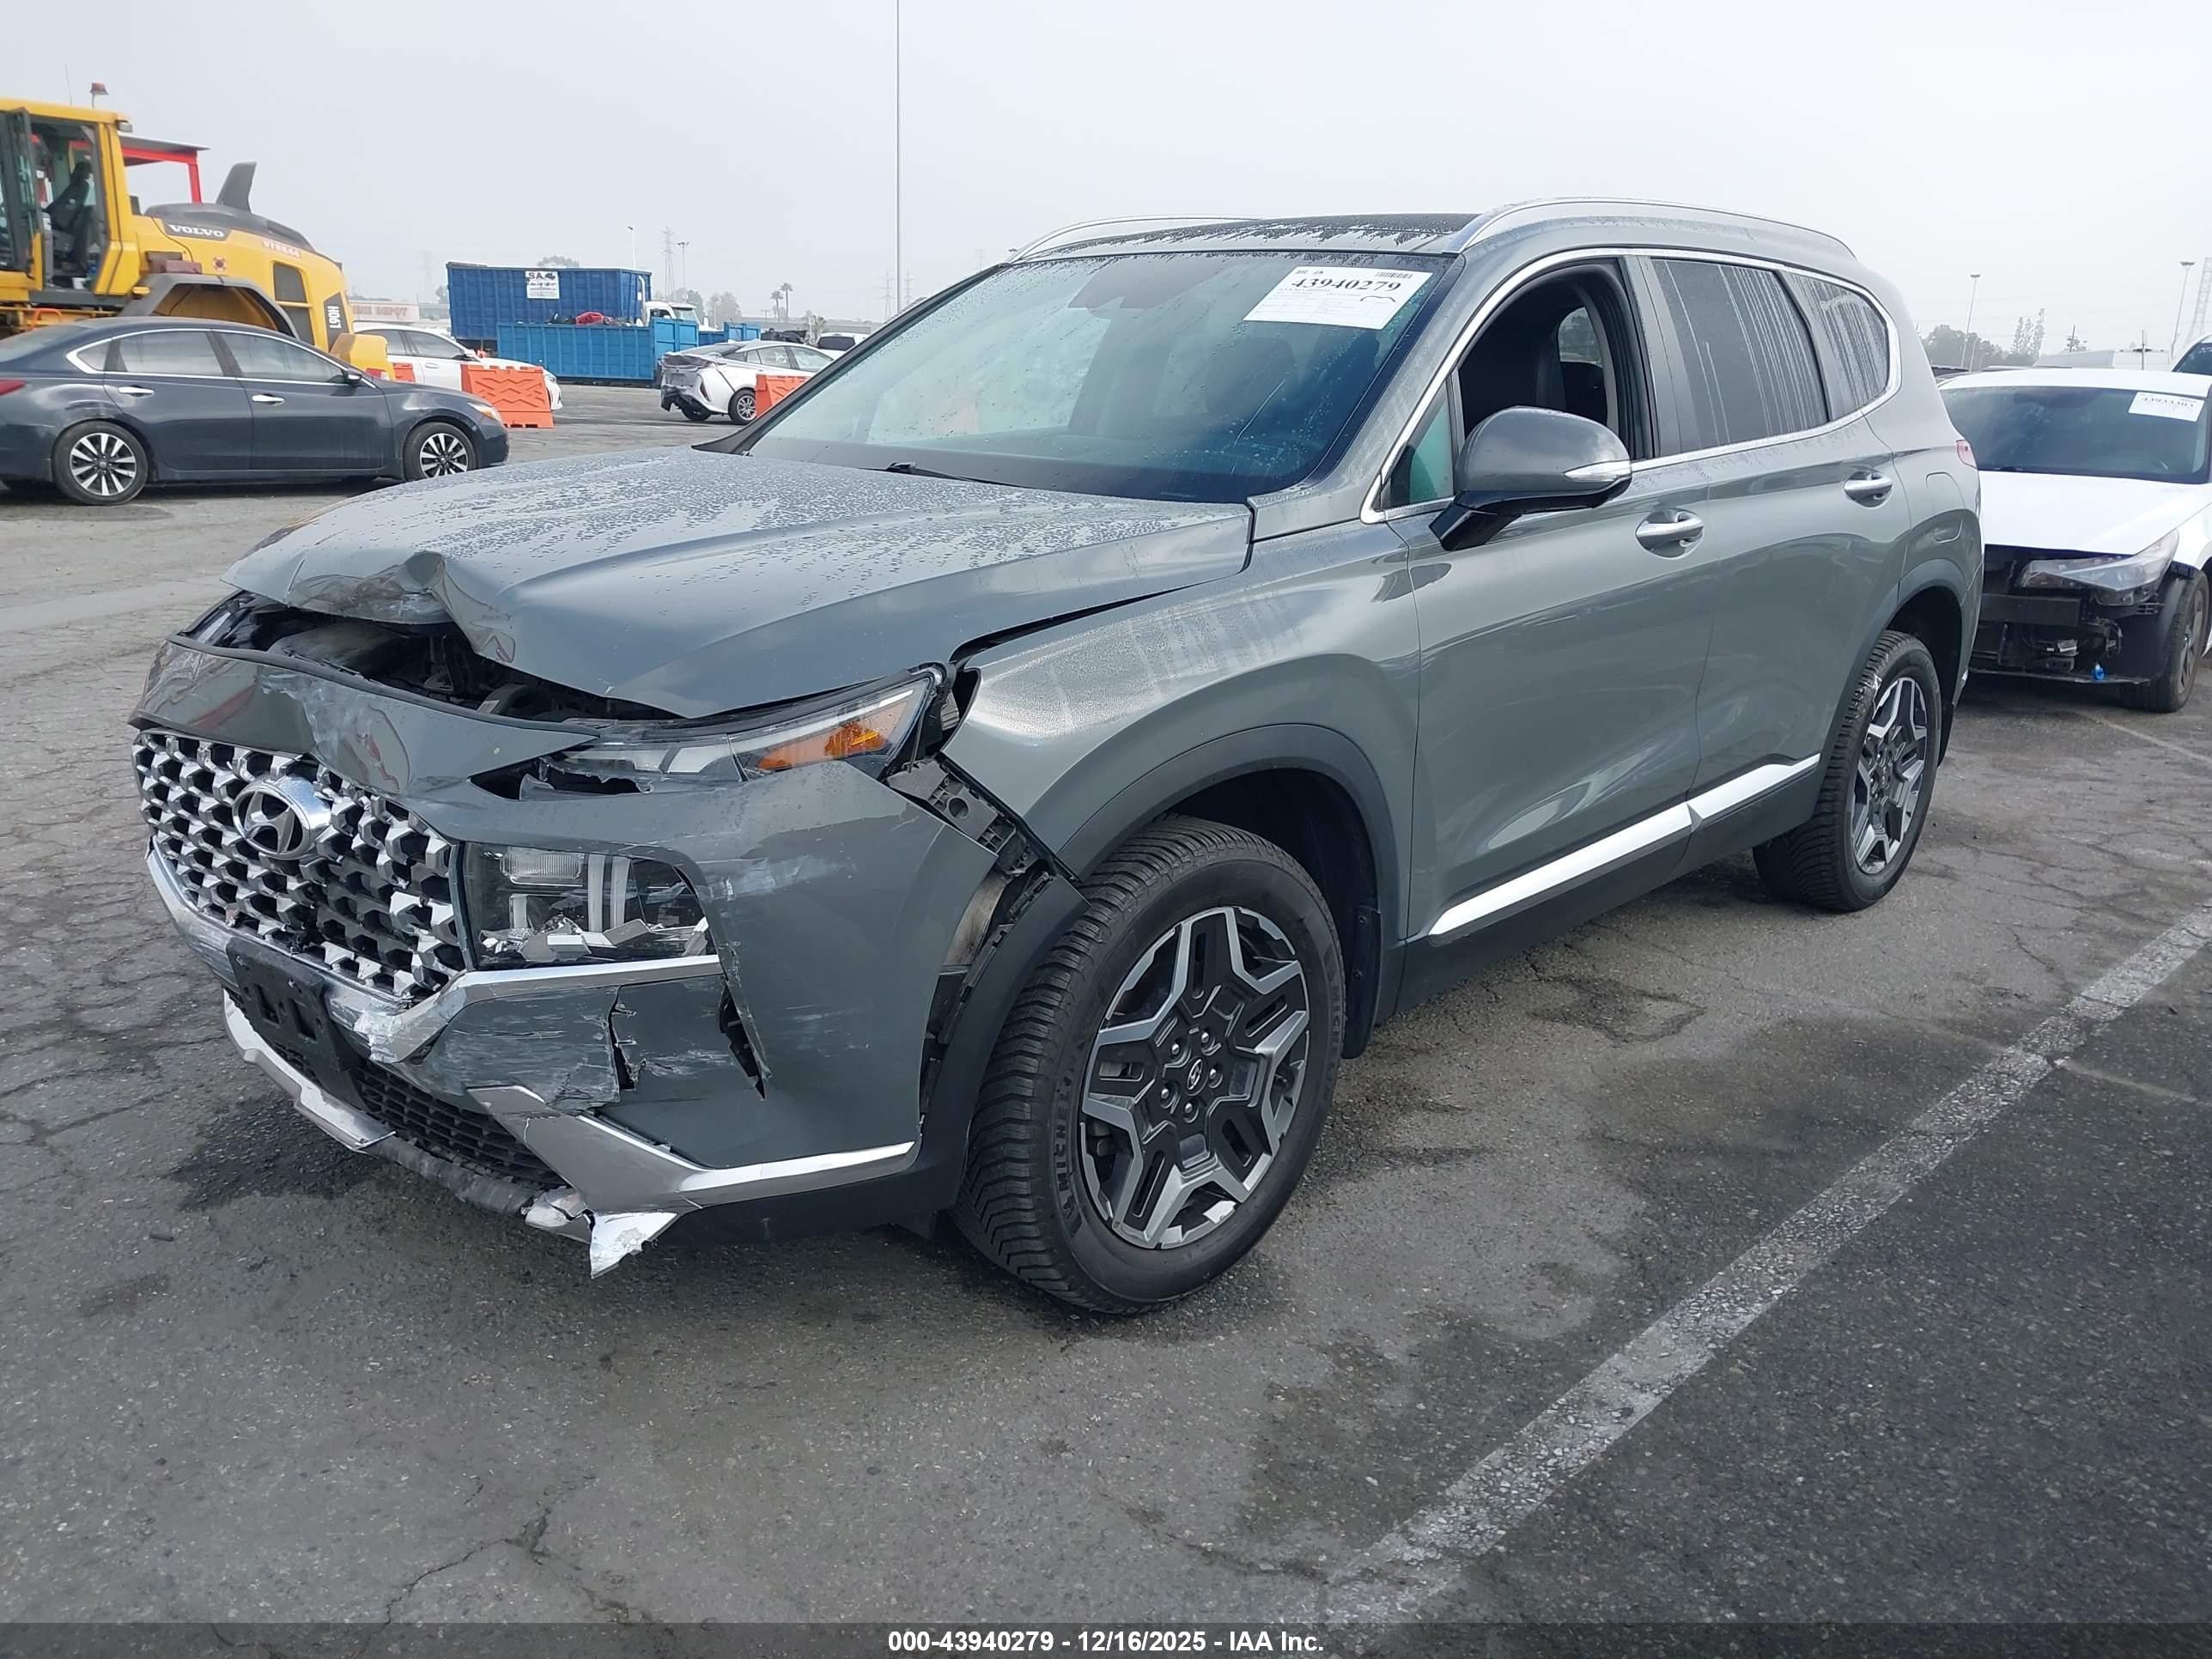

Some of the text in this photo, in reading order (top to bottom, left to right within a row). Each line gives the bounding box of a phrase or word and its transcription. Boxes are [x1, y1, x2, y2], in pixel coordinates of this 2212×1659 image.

[168, 224, 225, 238] VOLVO
[1291, 277, 1402, 293] 43940279
[327, 305, 343, 329] L90H
